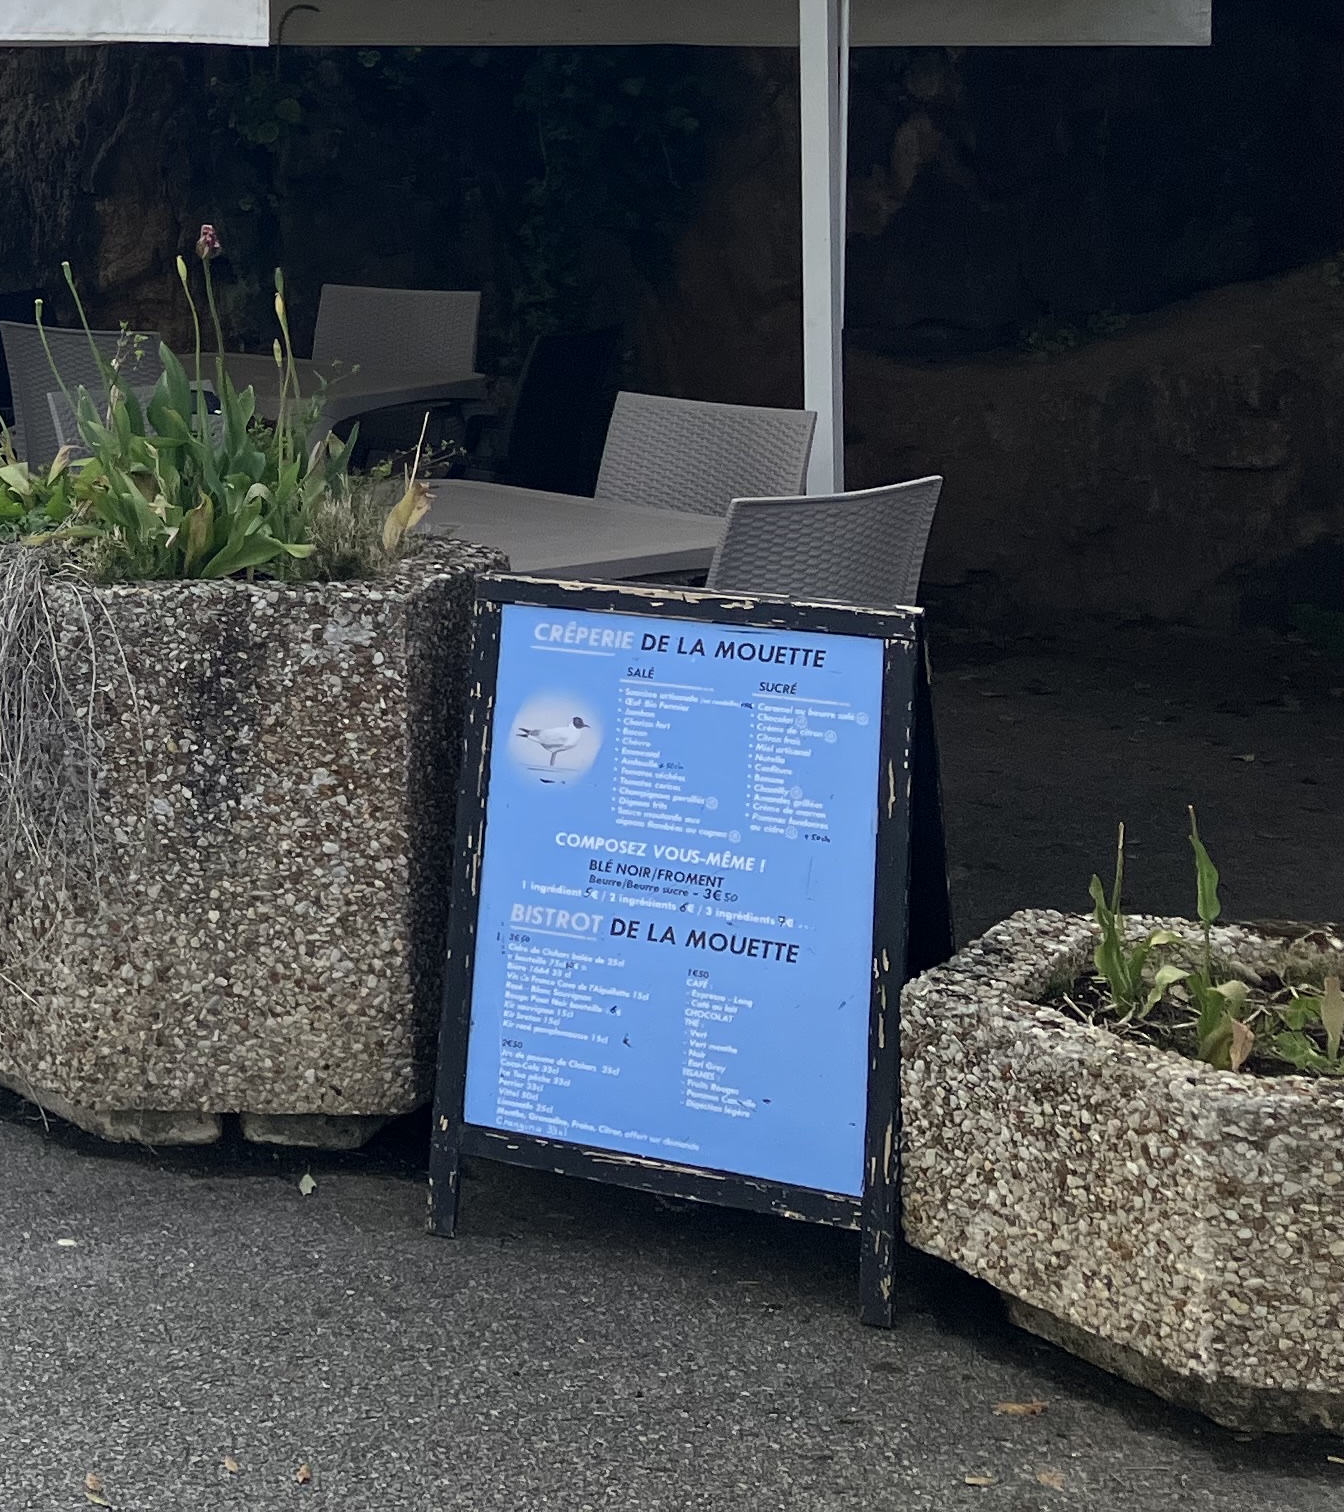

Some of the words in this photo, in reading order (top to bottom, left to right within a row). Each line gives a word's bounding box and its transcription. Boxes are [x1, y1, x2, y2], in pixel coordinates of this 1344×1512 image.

[533, 616, 635, 650] CRÊPERIE
[640, 632, 671, 653] DE
[676, 635, 706, 657] LA
[714, 639, 827, 669] MOUETTE
[626, 664, 654, 679] SALÉ
[758, 678, 798, 695] SUCRÉ
[756, 701, 793, 714] Caramel
[754, 743, 774, 753] Miel
[754, 753, 785, 765] Nutella
[554, 830, 648, 858] COMPOSEZ
[651, 840, 756, 872] VOUS-MÊME
[588, 855, 613, 873] BLÉ
[615, 861, 726, 891] NOIR/FROMENT
[587, 873, 660, 894] Beurre/Beurre
[529, 880, 582, 899] ingrédient
[608, 892, 616, 902] 2
[704, 905, 712, 916] 3
[714, 906, 775, 927] ingrédients
[509, 901, 604, 935] BISTROT
[609, 916, 640, 940] DE
[646, 921, 677, 945] LA
[684, 927, 800, 964] MOUETTE
[732, 995, 753, 1009] Long
[684, 1007, 733, 1024] CHOCOLAT
